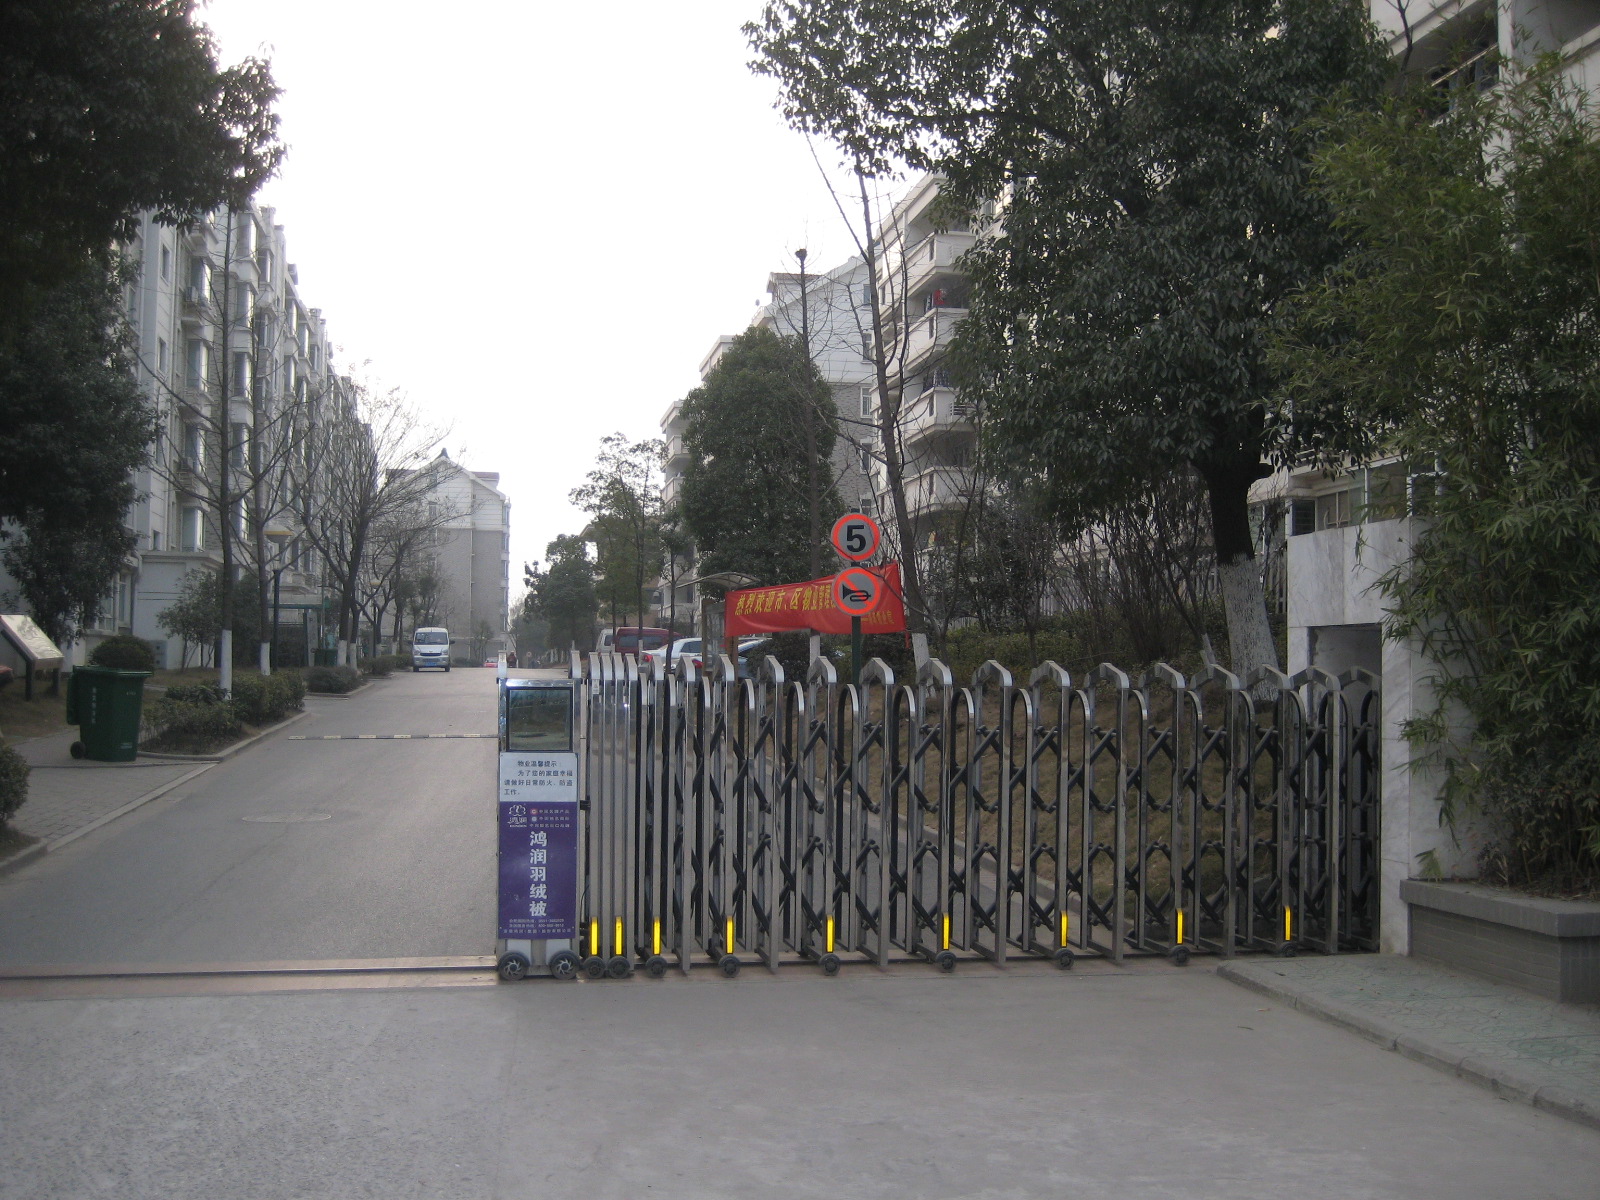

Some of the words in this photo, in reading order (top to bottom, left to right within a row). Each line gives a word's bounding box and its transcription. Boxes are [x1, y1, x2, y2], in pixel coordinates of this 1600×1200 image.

[846, 524, 866, 553] 5
[529, 830, 548, 917] 鸿润羽绒被
